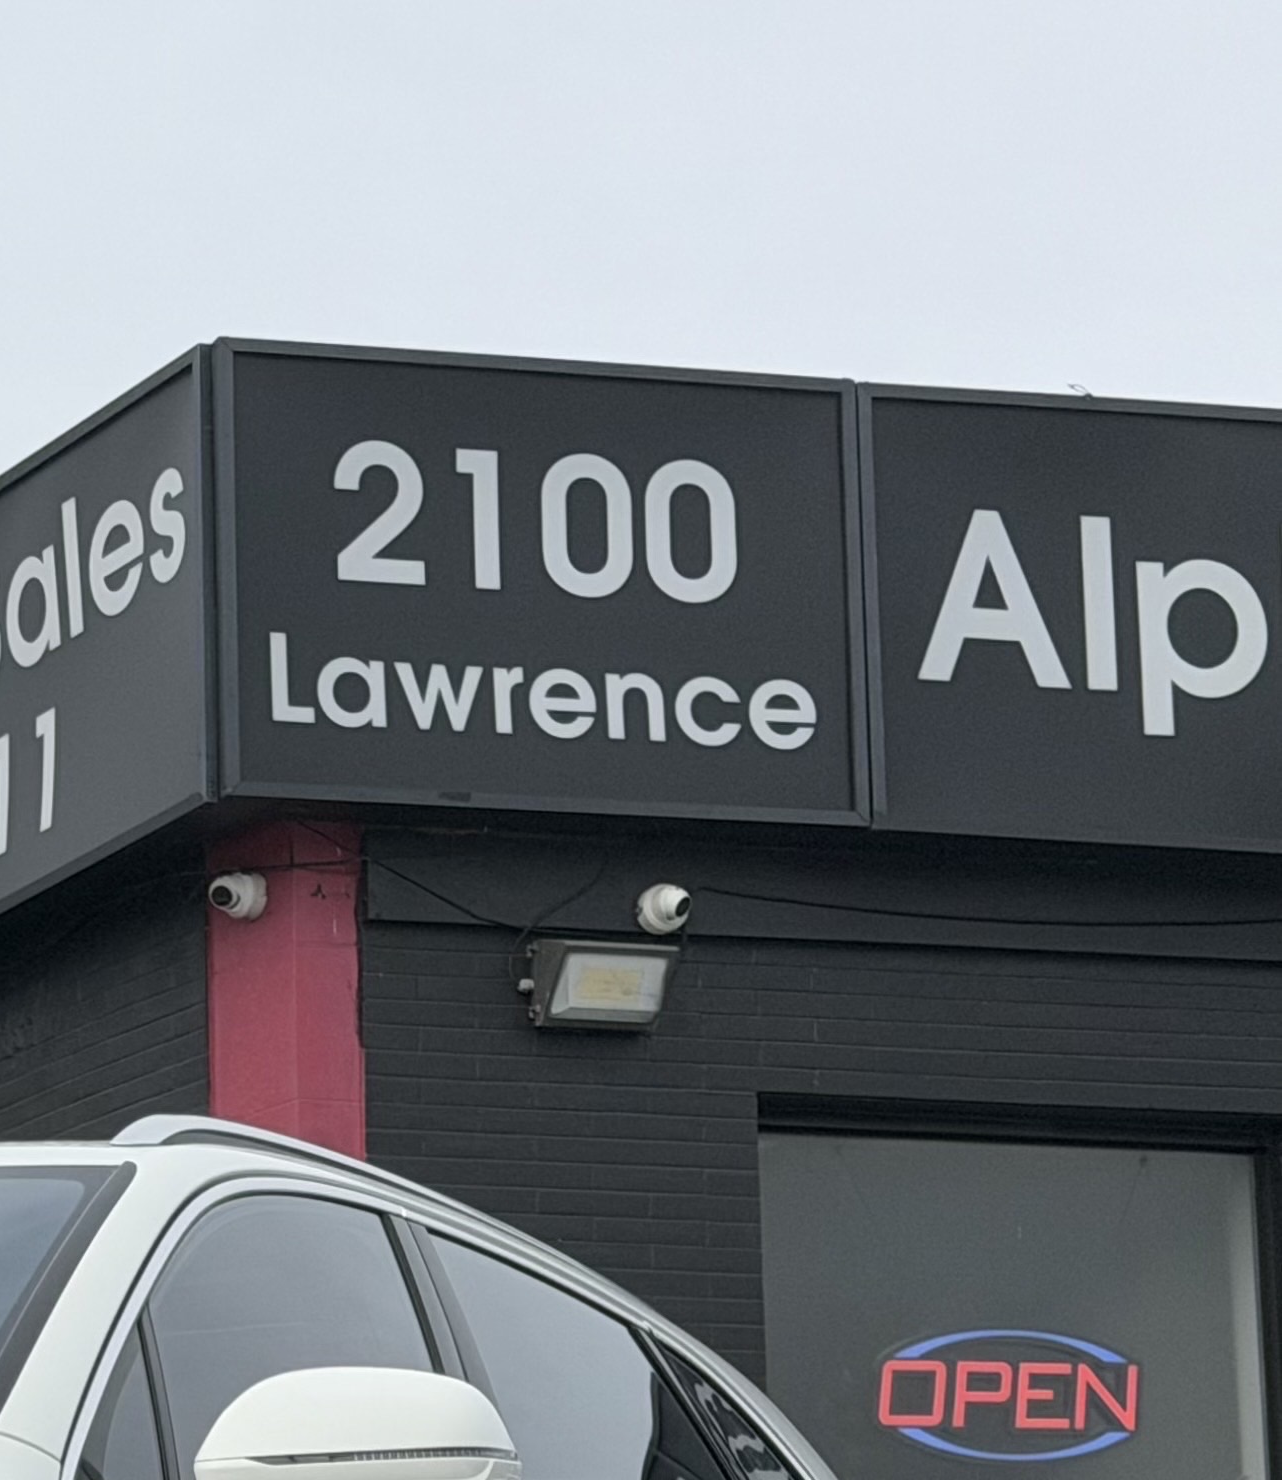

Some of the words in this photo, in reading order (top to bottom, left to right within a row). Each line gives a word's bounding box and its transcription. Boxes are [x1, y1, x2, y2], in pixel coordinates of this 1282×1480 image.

[332, 439, 739, 604] 2100
[268, 630, 818, 752] Lawrence
[916, 507, 1270, 738] Alp
[878, 1358, 1141, 1433] OPEN
